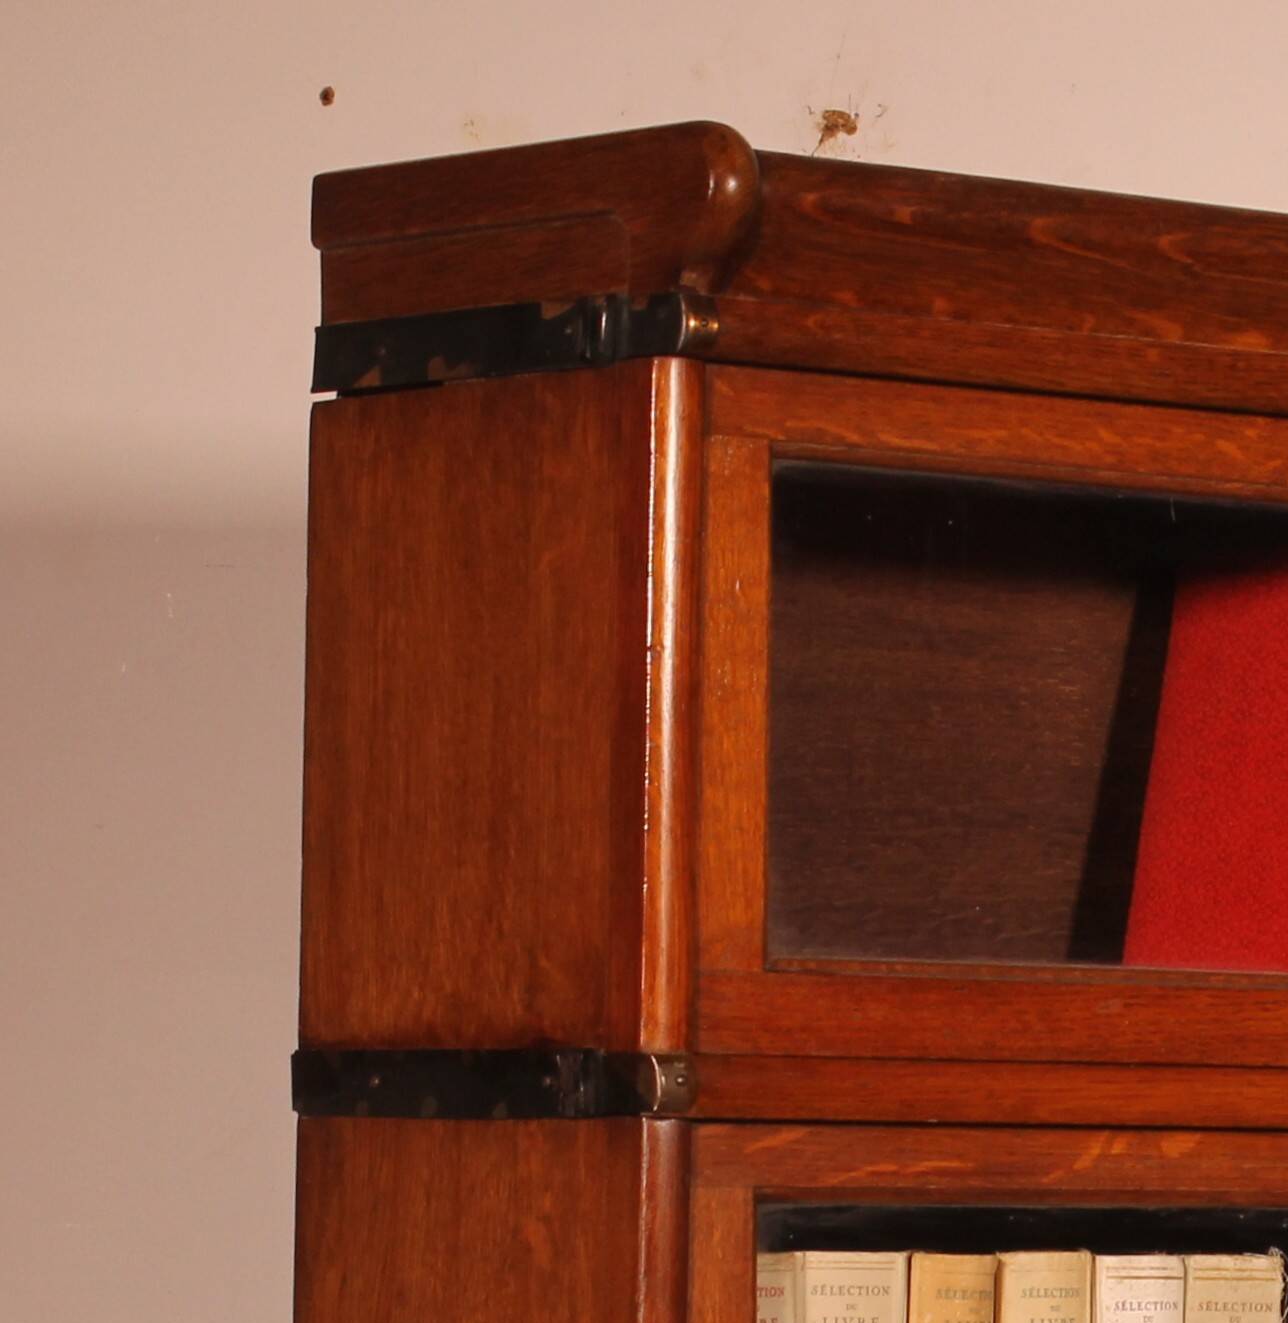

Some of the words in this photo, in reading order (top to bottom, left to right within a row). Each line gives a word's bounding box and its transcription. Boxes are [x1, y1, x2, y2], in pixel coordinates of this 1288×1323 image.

[810, 1283, 891, 1297] SÉLECTION
[1020, 1285, 1081, 1299] SÉLECTION
[1114, 1299, 1179, 1312] SÉLECTION
[1198, 1300, 1273, 1313] SÉLECTION
